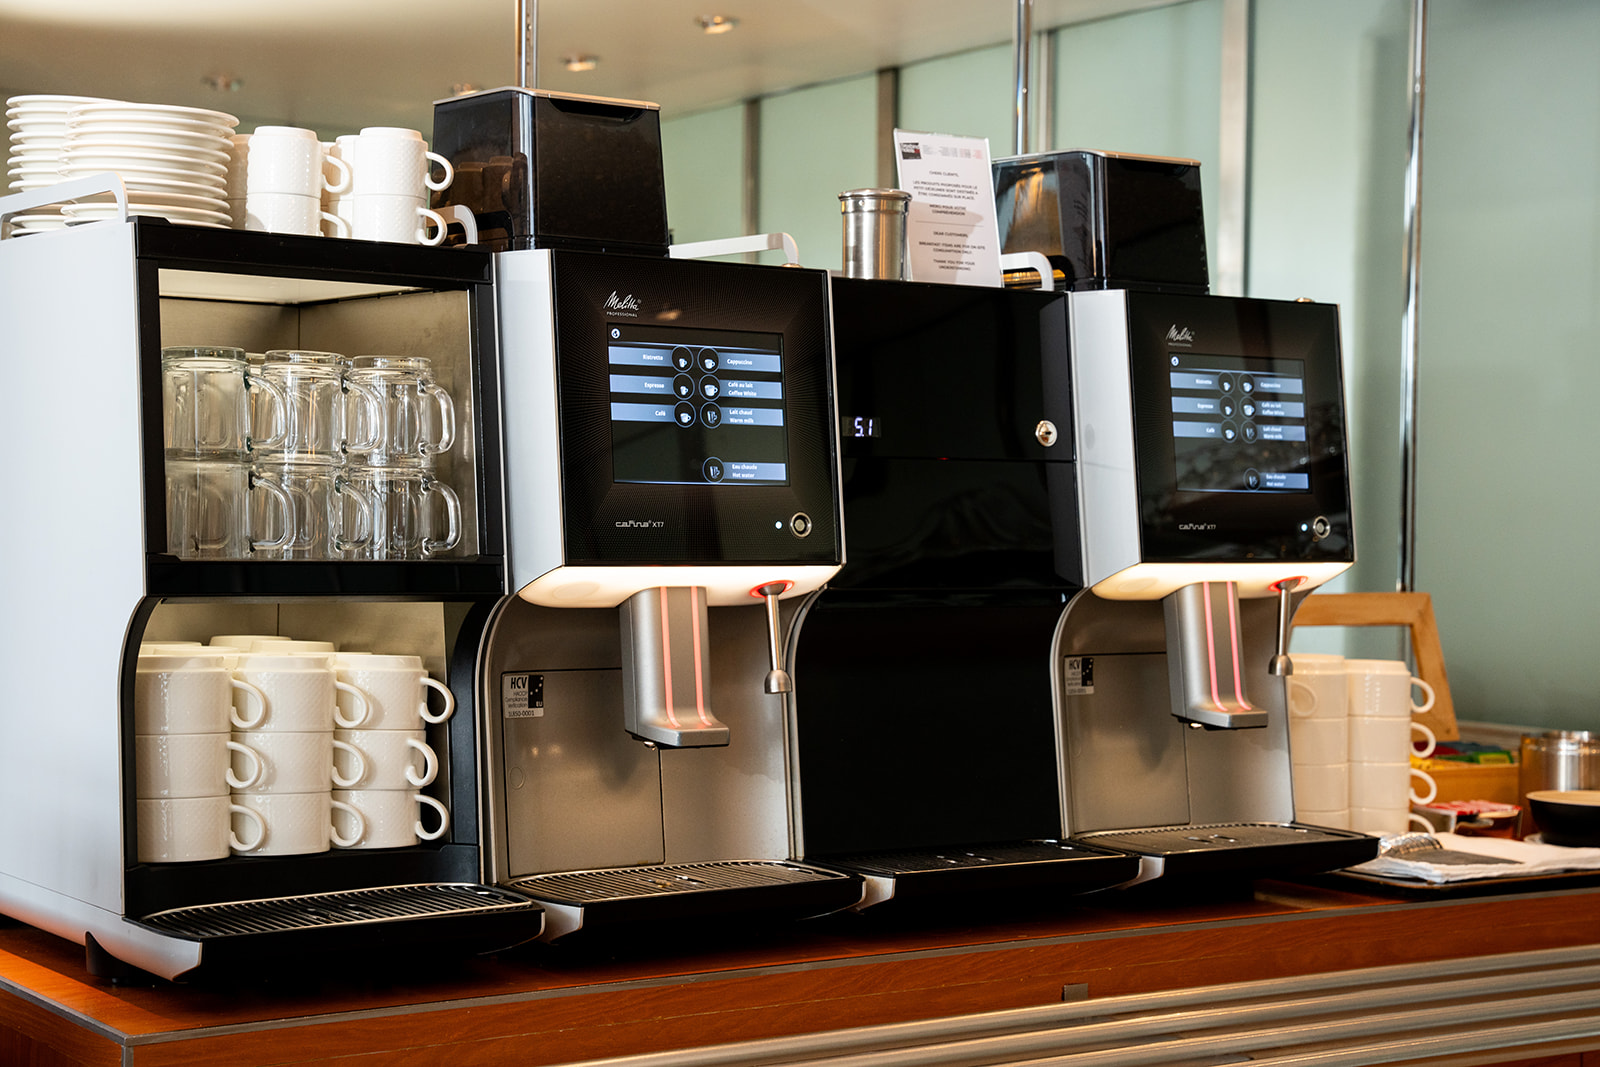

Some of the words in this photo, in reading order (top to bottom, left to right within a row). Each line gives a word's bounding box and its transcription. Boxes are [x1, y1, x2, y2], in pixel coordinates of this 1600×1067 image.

[726, 358, 753, 366] Cappuccino
[644, 382, 665, 390] Espresso
[510, 676, 528, 689] HCV
